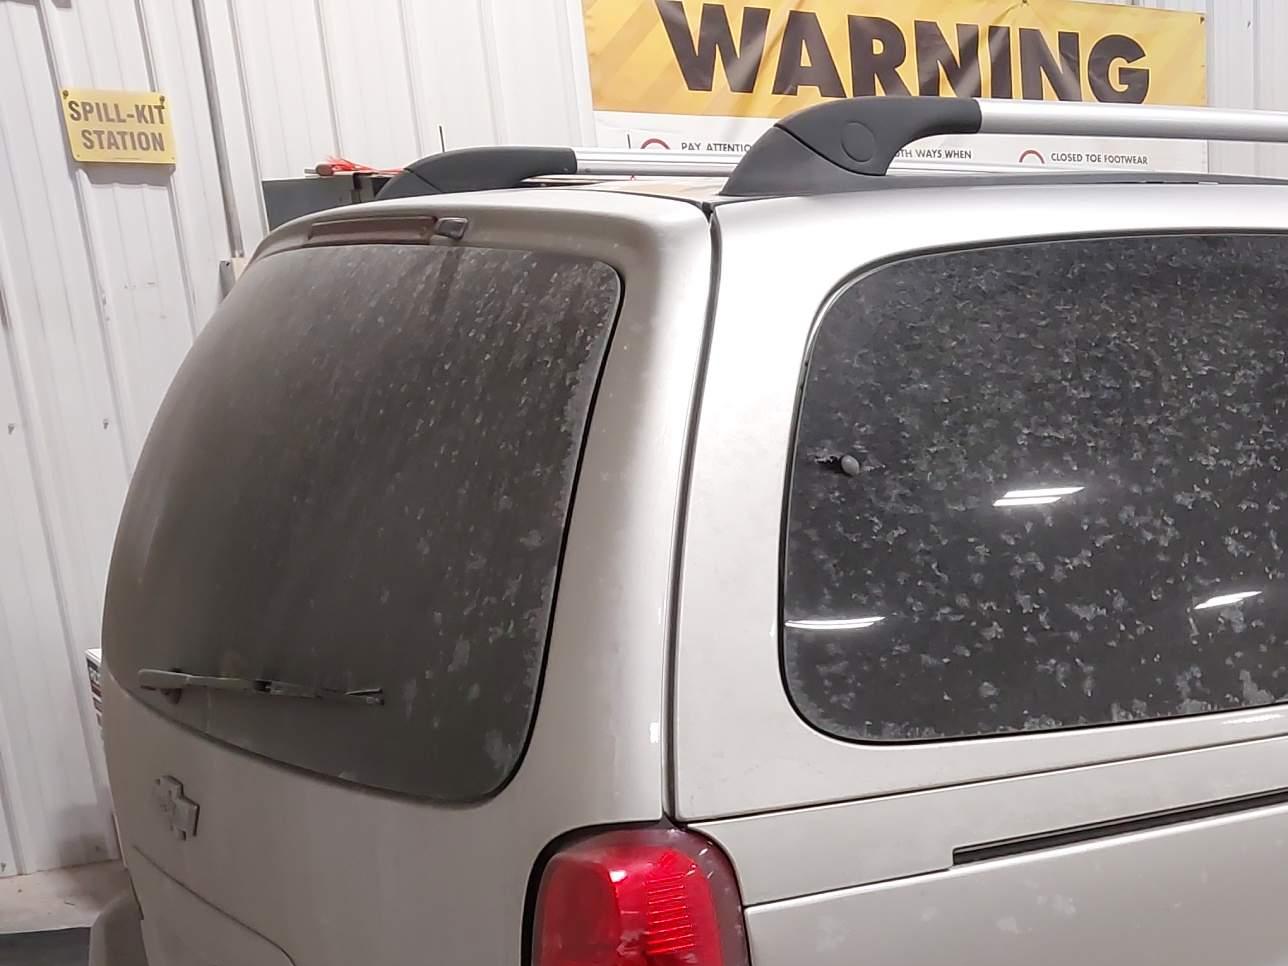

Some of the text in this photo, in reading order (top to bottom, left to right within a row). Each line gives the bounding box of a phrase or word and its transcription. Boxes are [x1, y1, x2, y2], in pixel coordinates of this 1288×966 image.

[657, 0, 1150, 104] WARNING
[68, 100, 166, 124] SPILL-KIT
[81, 129, 166, 151] STATION
[681, 142, 753, 152] PAY ATTENTIO
[916, 149, 942, 158] WAYS
[943, 150, 971, 159] WHEN
[1051, 153, 1148, 164] CLOSED TOE FOOTWEAR
